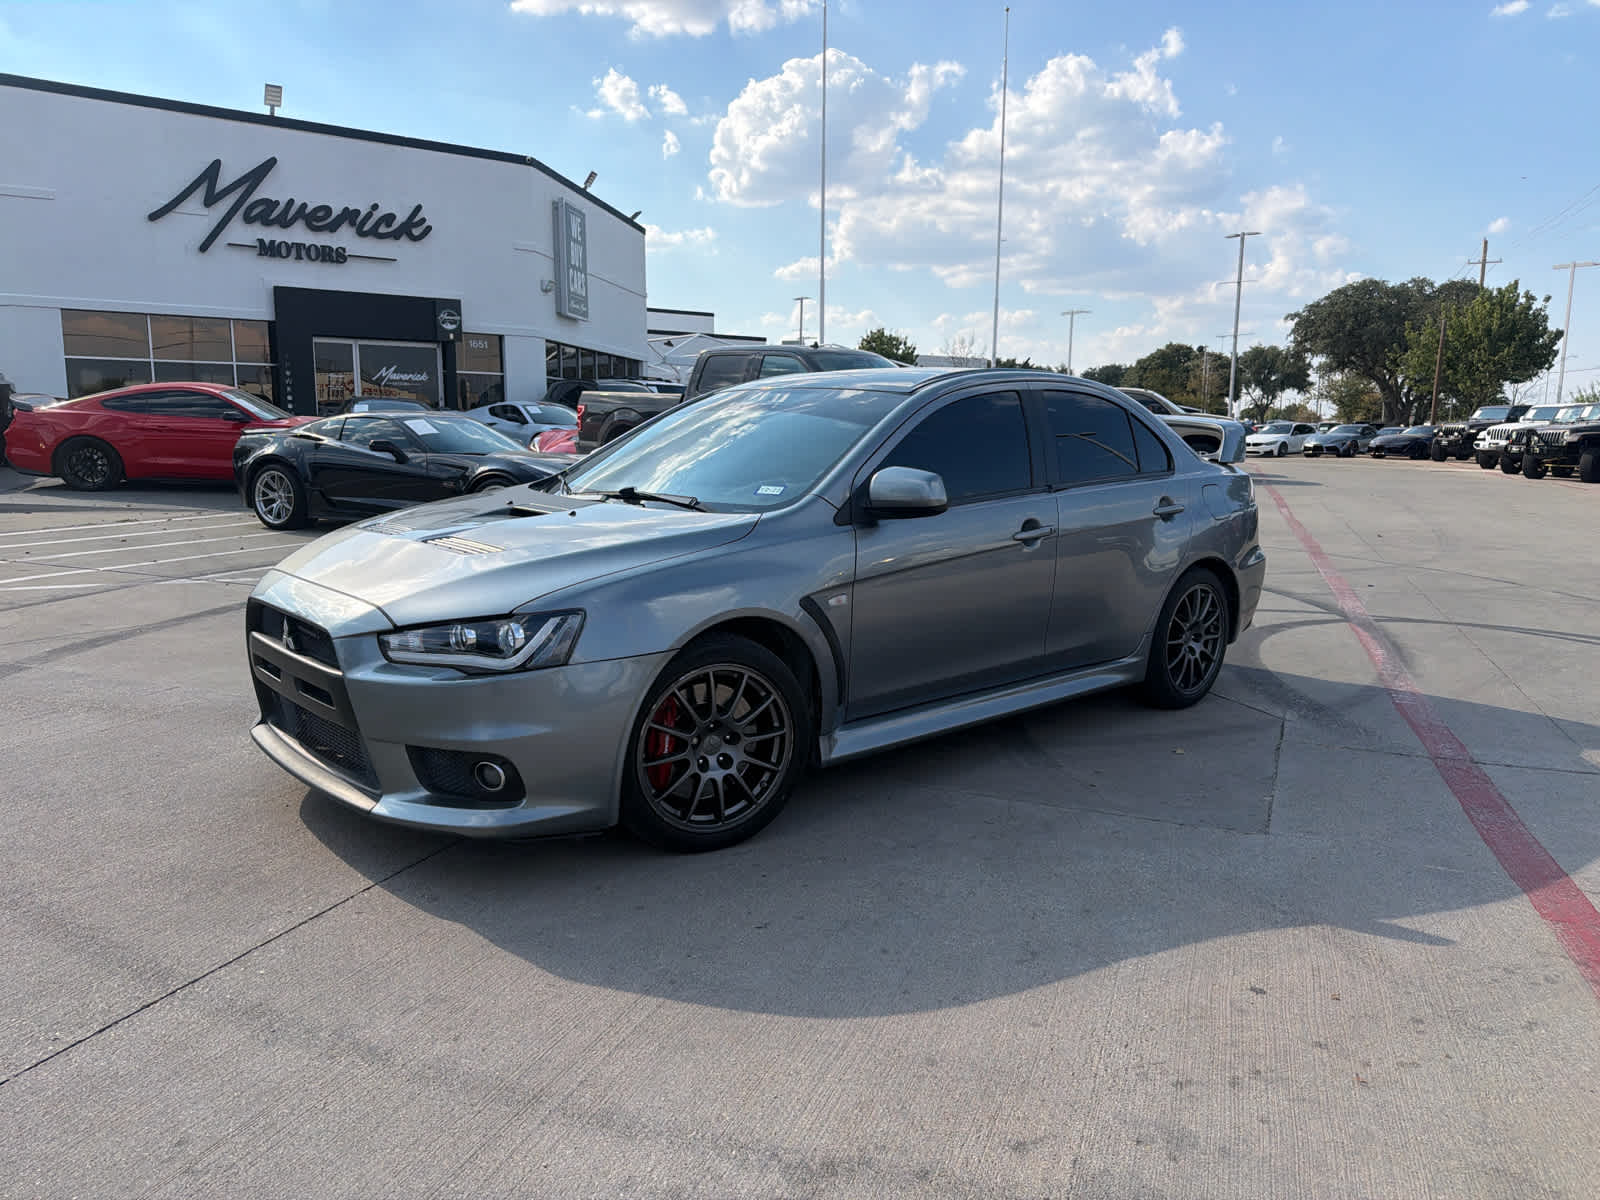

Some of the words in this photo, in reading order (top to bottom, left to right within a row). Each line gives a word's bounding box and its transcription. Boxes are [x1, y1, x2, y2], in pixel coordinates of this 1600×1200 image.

[148, 156, 432, 253] Maverick
[569, 213, 581, 241] WE
[256, 238, 348, 264] MOTORS
[570, 240, 583, 268] BUY
[569, 267, 586, 297] CARS
[469, 339, 489, 349] 1651
[372, 364, 429, 385] Maverick
